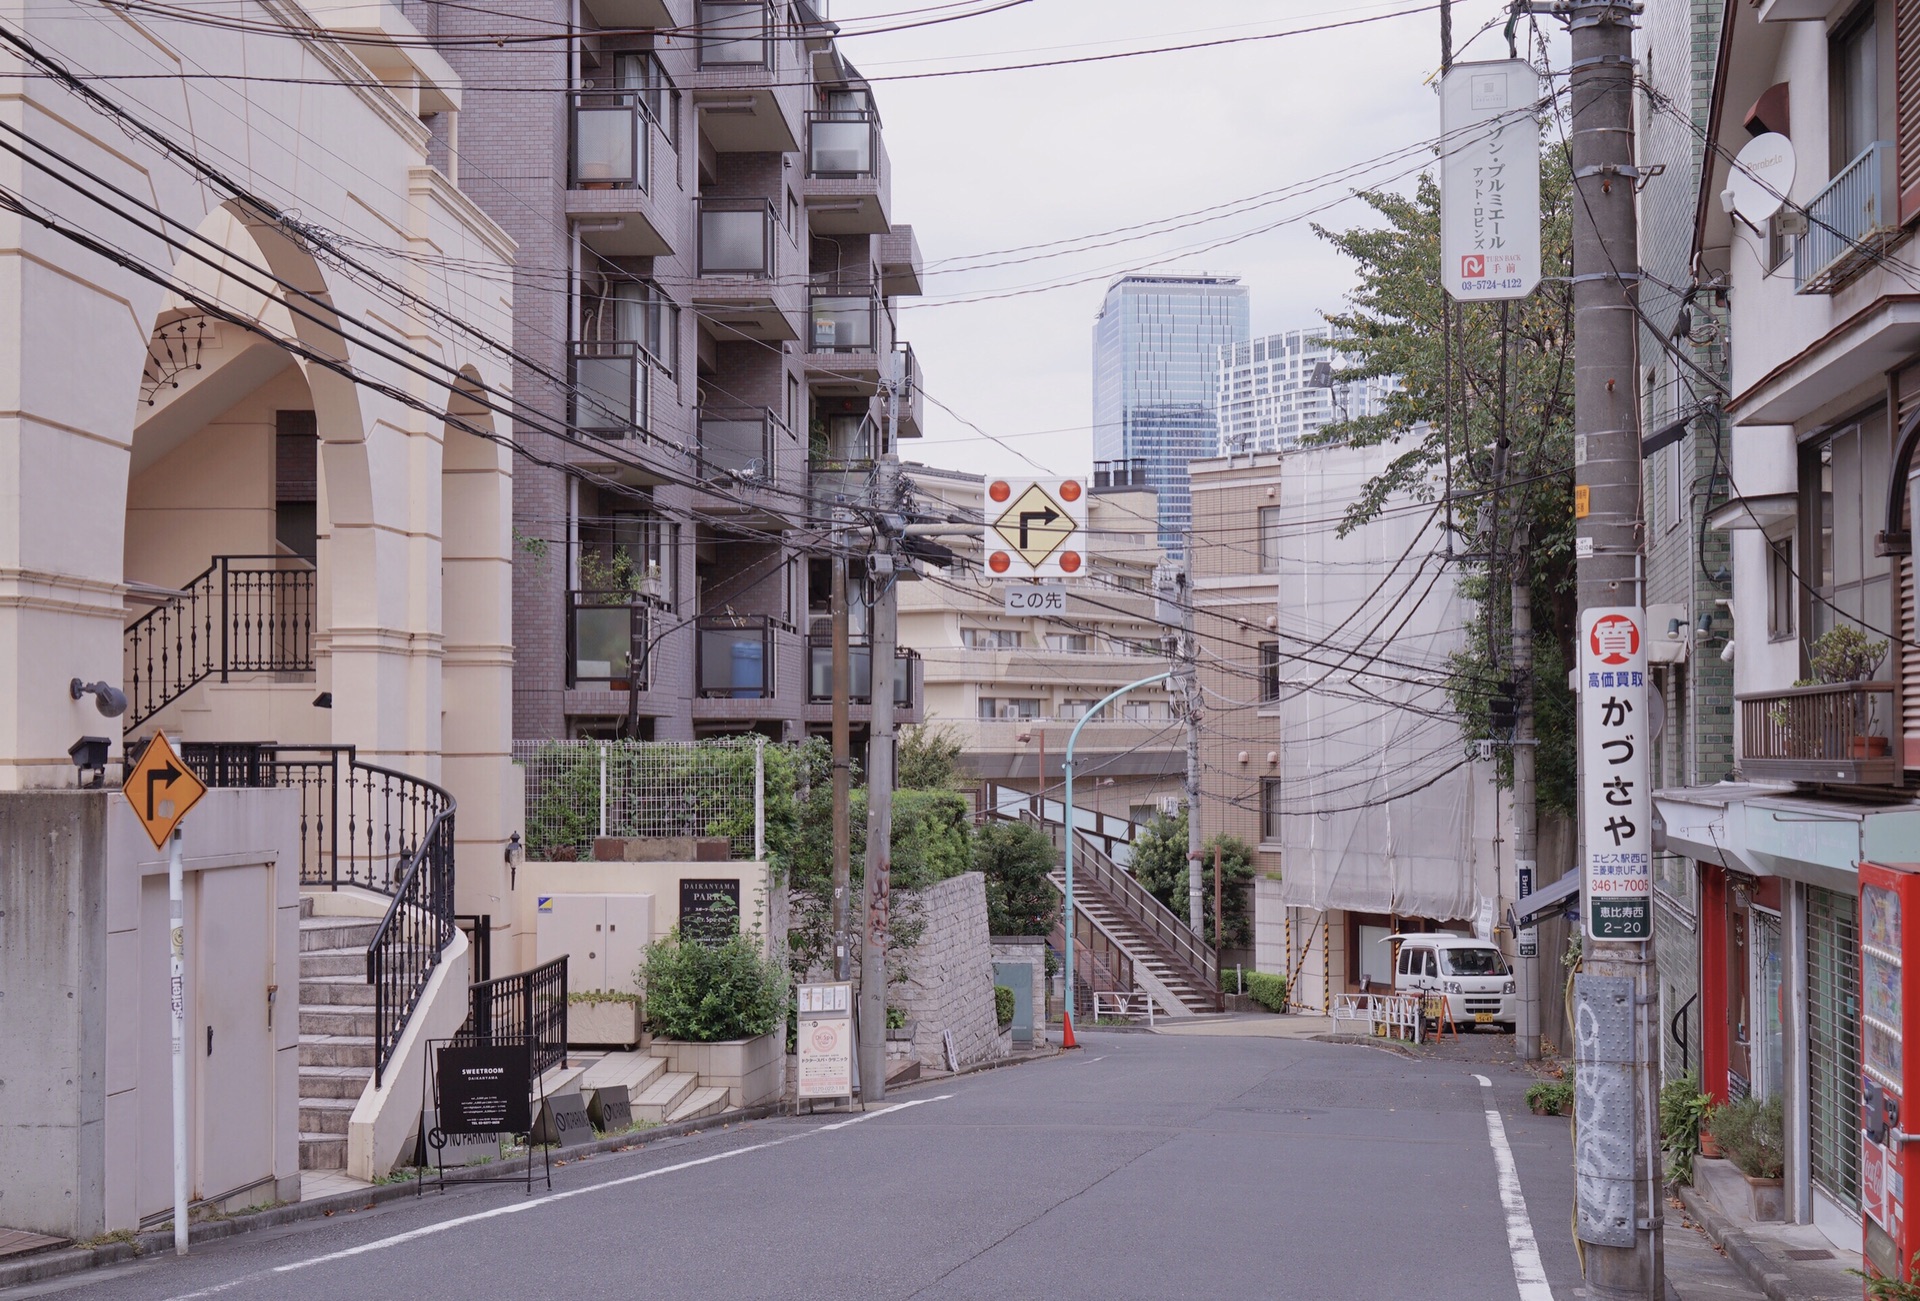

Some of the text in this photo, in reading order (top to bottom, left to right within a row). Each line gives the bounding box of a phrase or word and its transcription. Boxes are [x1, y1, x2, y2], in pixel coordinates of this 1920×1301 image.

[1473, 167, 1484, 250] アット・ロビンズ
[1461, 278, 1522, 290] 03-5724-4122
[1010, 592, 1062, 609] この先
[1594, 619, 1636, 656] 質
[1588, 671, 1644, 688] 高価買取
[1601, 696, 1636, 847] かづさや
[1592, 853, 1648, 864] エビス駅西口
[1592, 865, 1648, 875] 三菱東京UFJ裏
[1592, 879, 1649, 892] 3461-7005
[1600, 906, 1644, 918] 恵比寿西
[1604, 922, 1641, 933] 2-20
